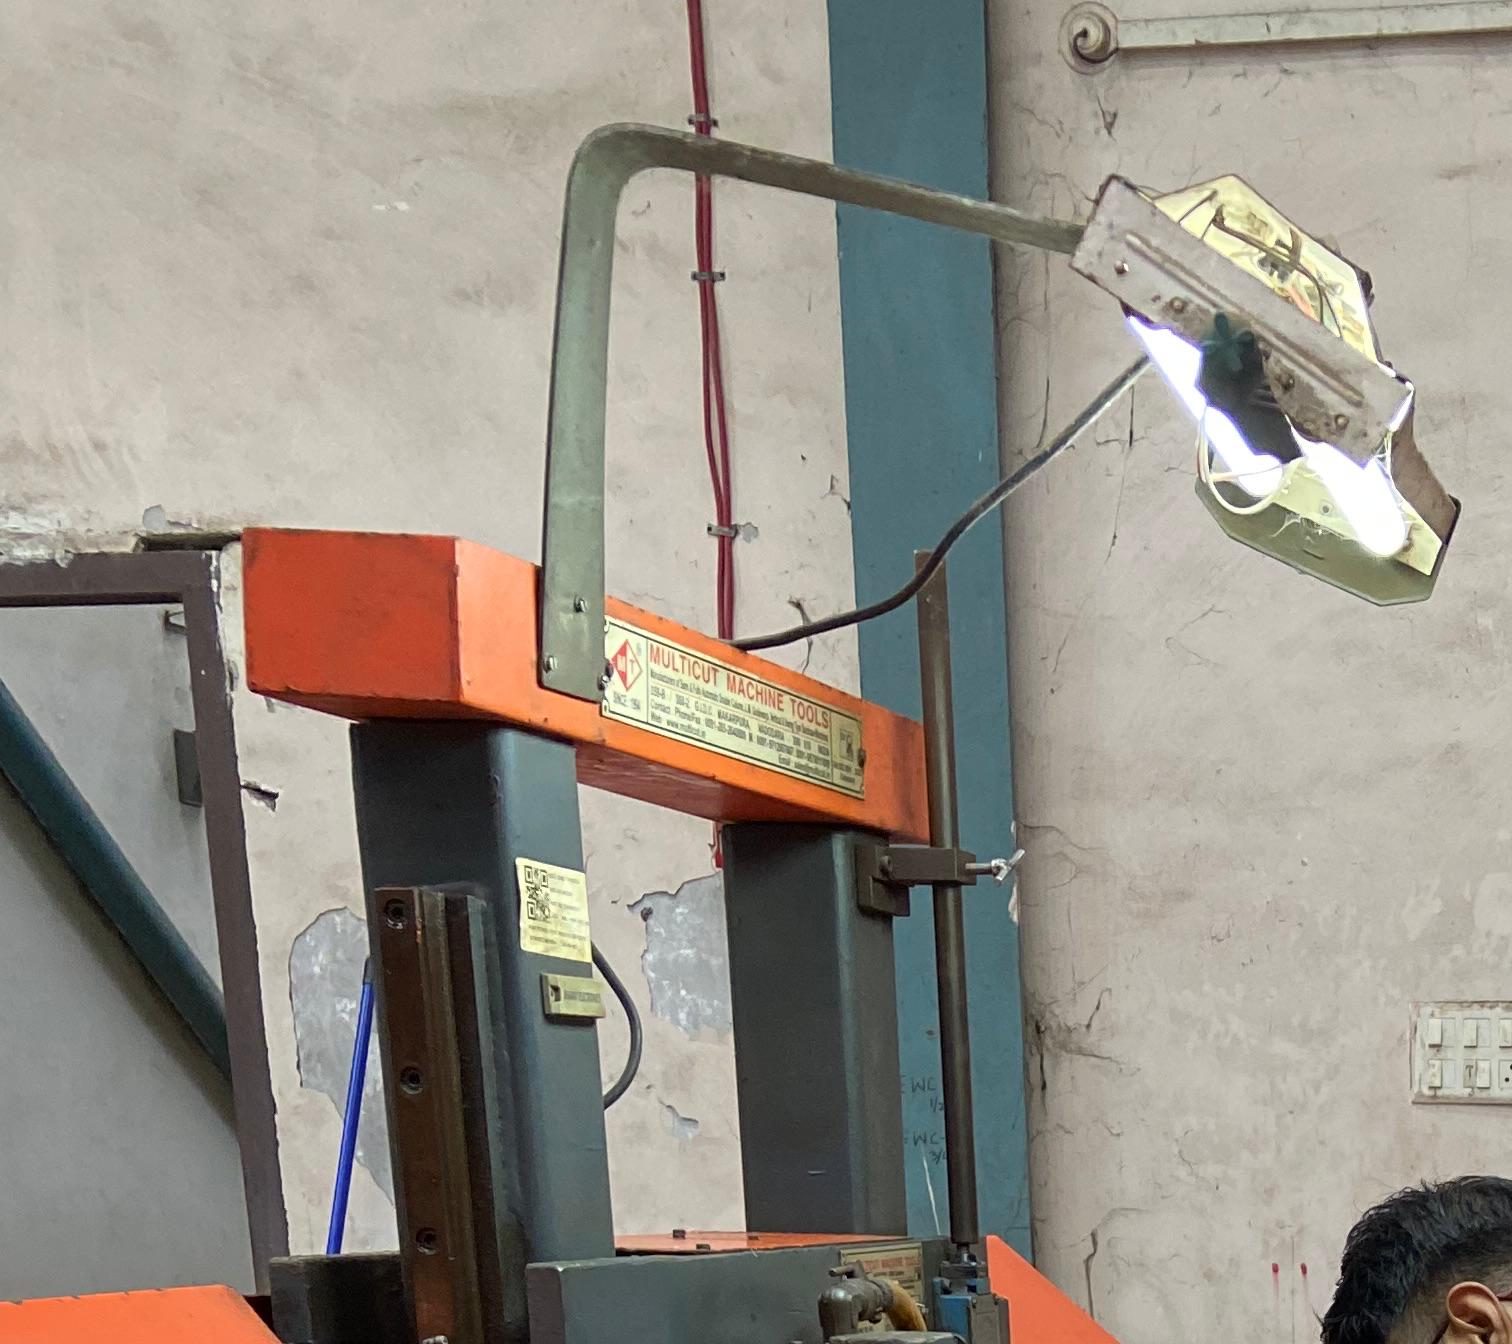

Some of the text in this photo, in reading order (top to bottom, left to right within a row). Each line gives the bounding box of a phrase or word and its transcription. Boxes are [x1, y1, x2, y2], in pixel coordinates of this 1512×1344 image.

[650, 643, 719, 687] MULTICUT
[727, 673, 784, 712] MACHINE
[789, 697, 829, 729] TOOLS
